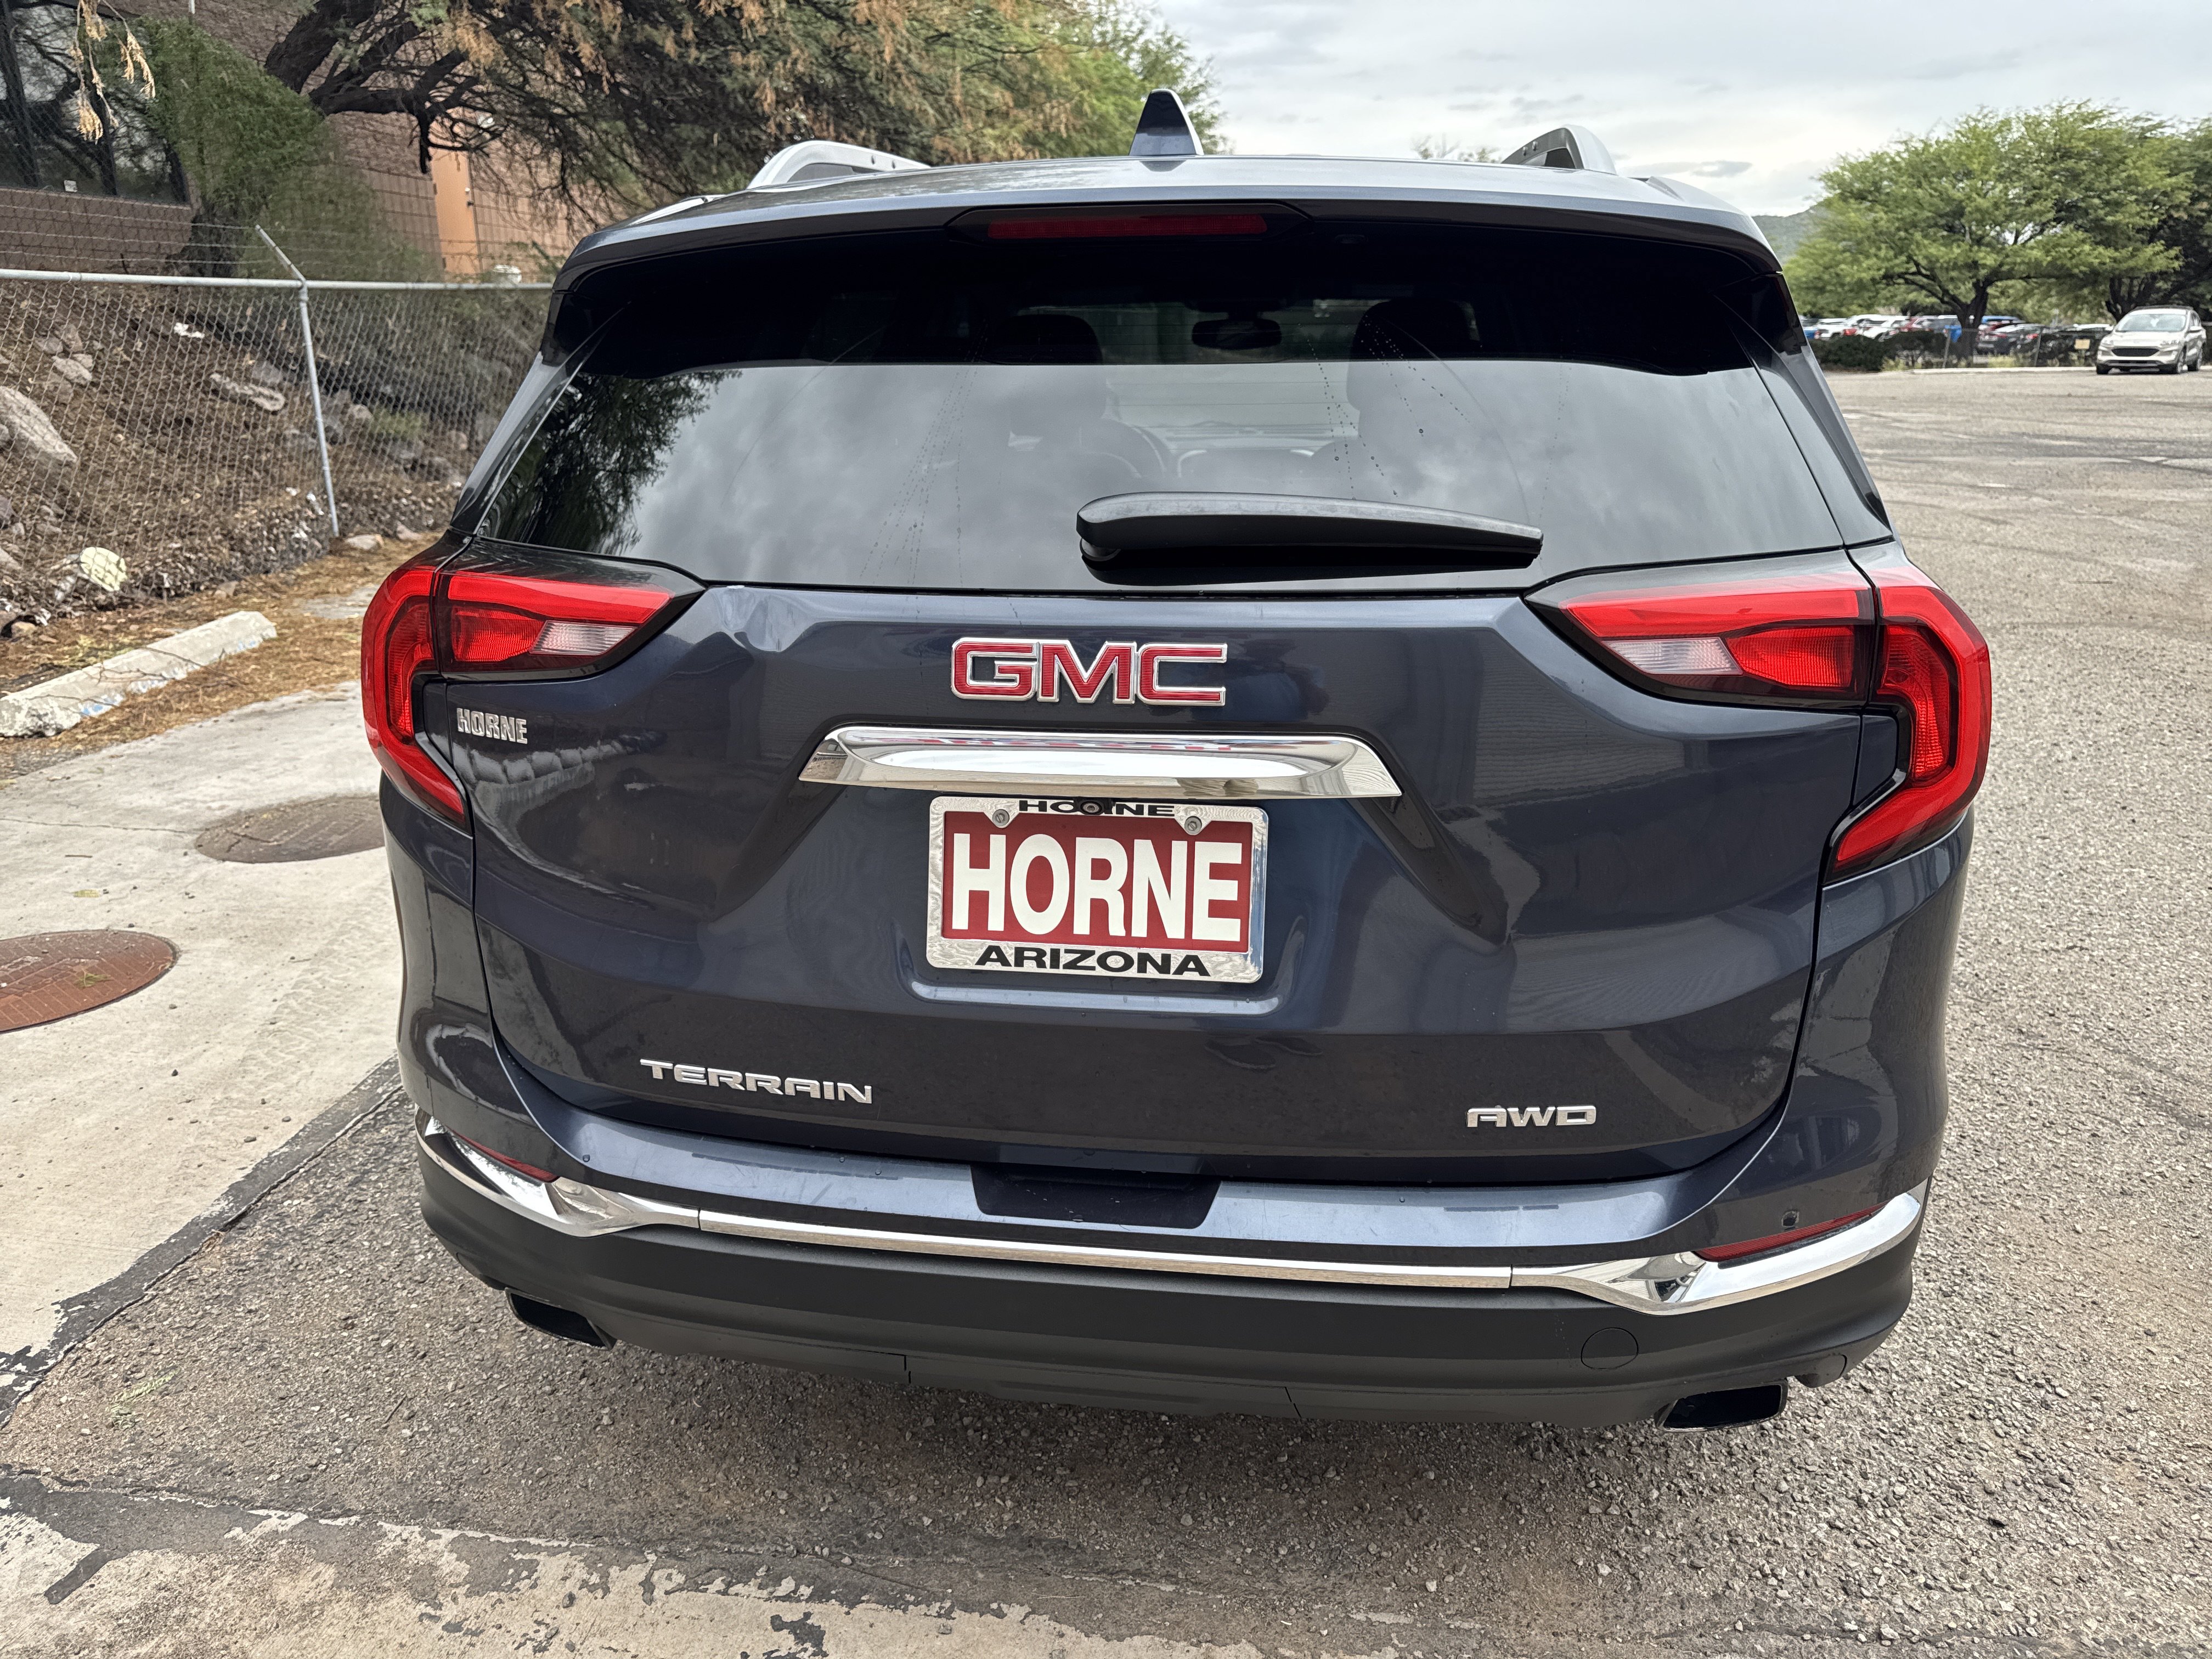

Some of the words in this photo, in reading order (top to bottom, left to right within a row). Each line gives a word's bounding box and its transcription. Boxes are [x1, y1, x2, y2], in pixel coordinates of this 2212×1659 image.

[951, 637, 1228, 706] GMC
[456, 708, 528, 744] HORNE
[1019, 800, 1175, 816] HONE
[952, 833, 1242, 941] HORNE
[974, 945, 1211, 977] ARIZONA
[640, 1059, 872, 1104] TERRAIN
[1466, 1105, 1596, 1127] AWD
